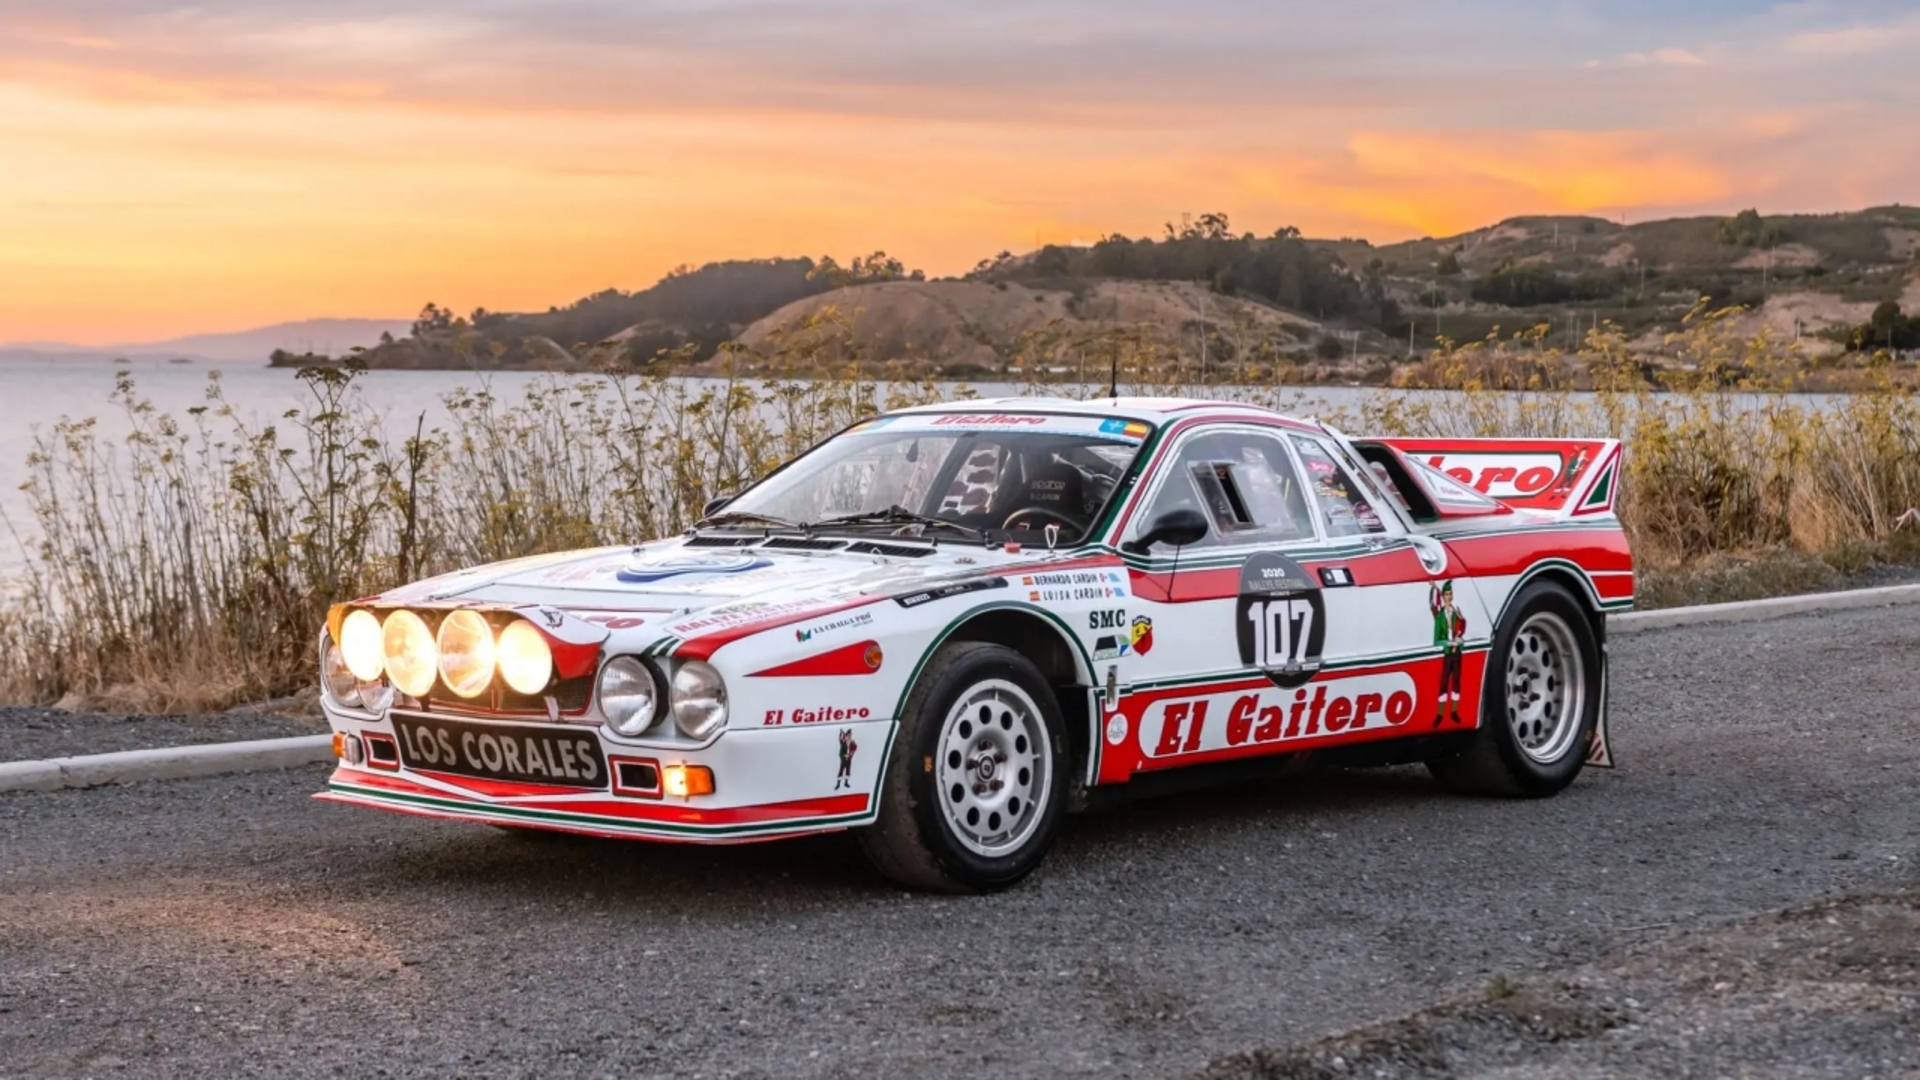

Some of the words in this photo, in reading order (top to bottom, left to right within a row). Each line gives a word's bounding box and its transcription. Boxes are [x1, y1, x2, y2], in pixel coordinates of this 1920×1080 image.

[1033, 574, 1072, 586] BERNARDO
[1072, 573, 1098, 584] CARDIN
[1261, 567, 1286, 578] 2020
[1043, 590, 1070, 601] LUISA
[1073, 588, 1103, 600] CARDIN
[1247, 579, 1275, 591] RALLYE
[1274, 578, 1307, 590] FESTIVAL
[1089, 609, 1126, 629] SMC
[1247, 599, 1314, 667] 107
[763, 709, 784, 726] El
[791, 706, 870, 724] Gaitero
[1154, 700, 1209, 757] El
[1226, 686, 1413, 746] Gaitero
[401, 724, 457, 766] LOS
[461, 731, 598, 780] CORALES
